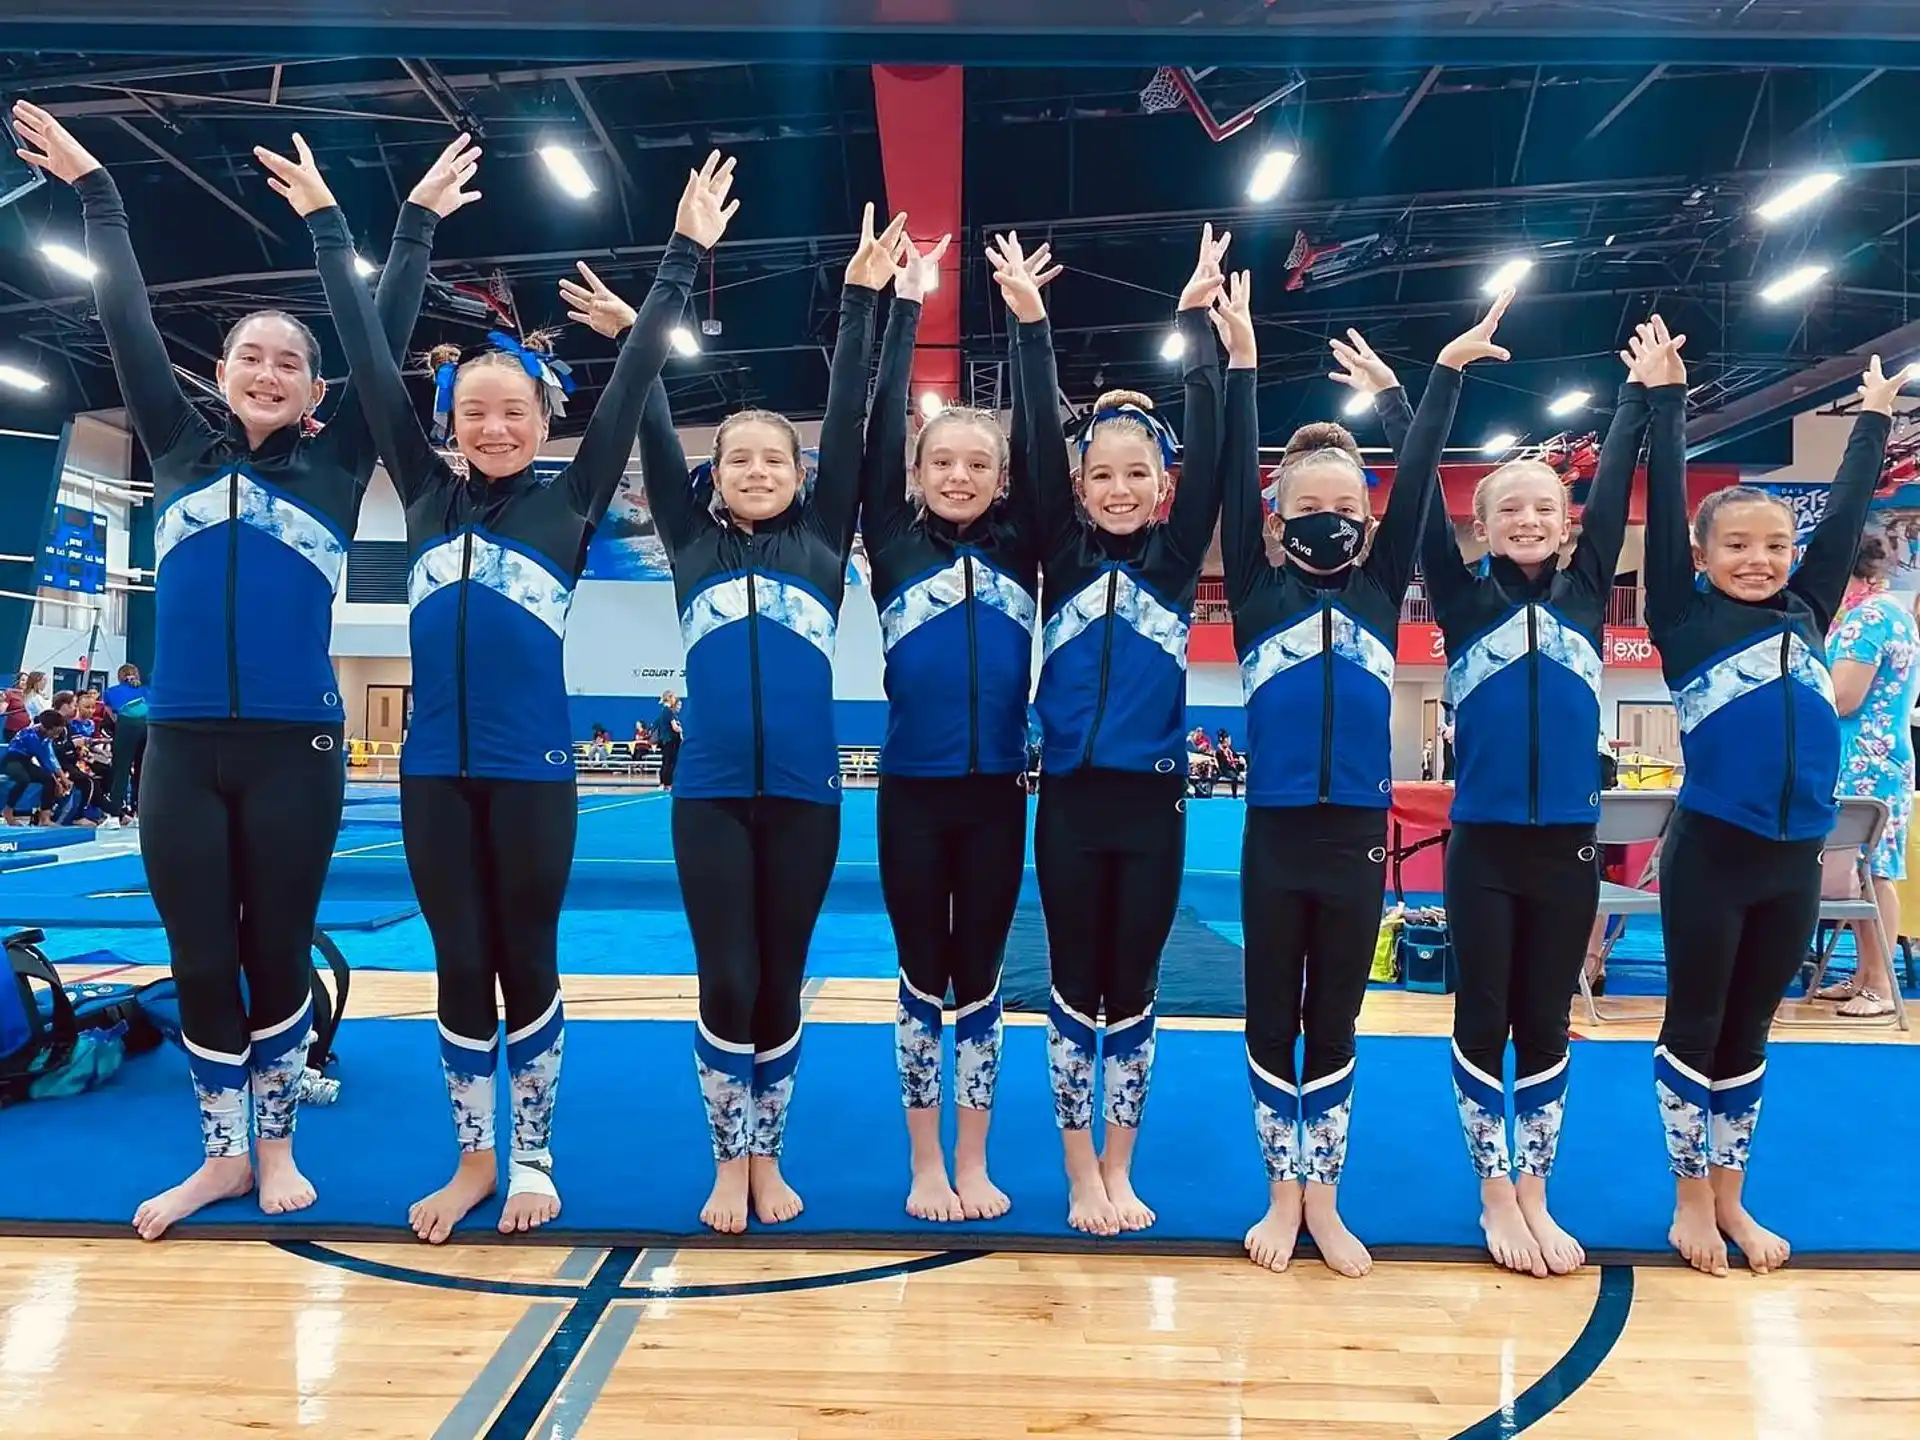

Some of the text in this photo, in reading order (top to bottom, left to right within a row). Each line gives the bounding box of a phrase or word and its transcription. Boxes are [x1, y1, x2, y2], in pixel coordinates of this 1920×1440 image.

[1290, 536, 1313, 557] Ava
[1613, 641, 1652, 663] exp
[641, 668, 676, 678] COURT
